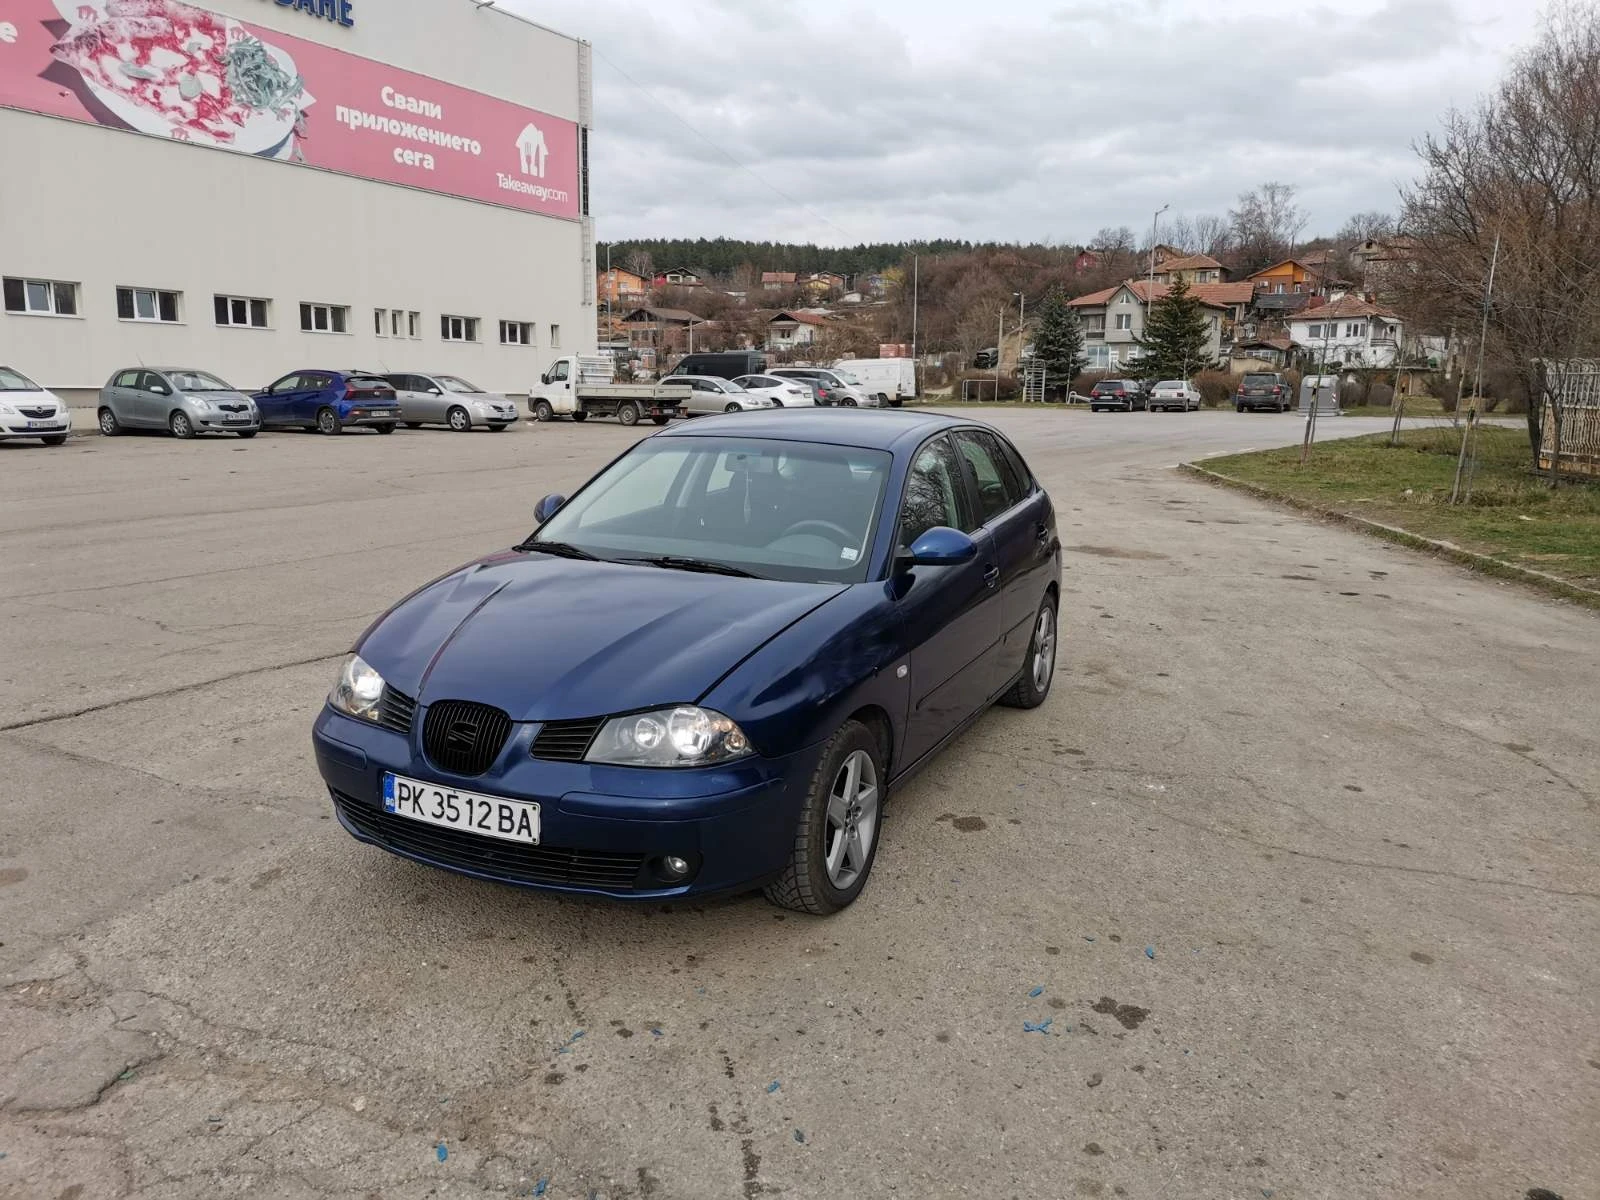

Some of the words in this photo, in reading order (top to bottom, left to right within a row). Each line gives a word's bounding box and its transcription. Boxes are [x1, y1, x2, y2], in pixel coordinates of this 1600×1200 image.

[381, 86, 442, 120] Свали
[335, 104, 482, 156] приложението
[393, 147, 435, 171] сега
[496, 172, 568, 204] Takeaway.com
[398, 782, 426, 816] PK
[431, 791, 492, 831] 3512
[498, 803, 533, 838] BA
